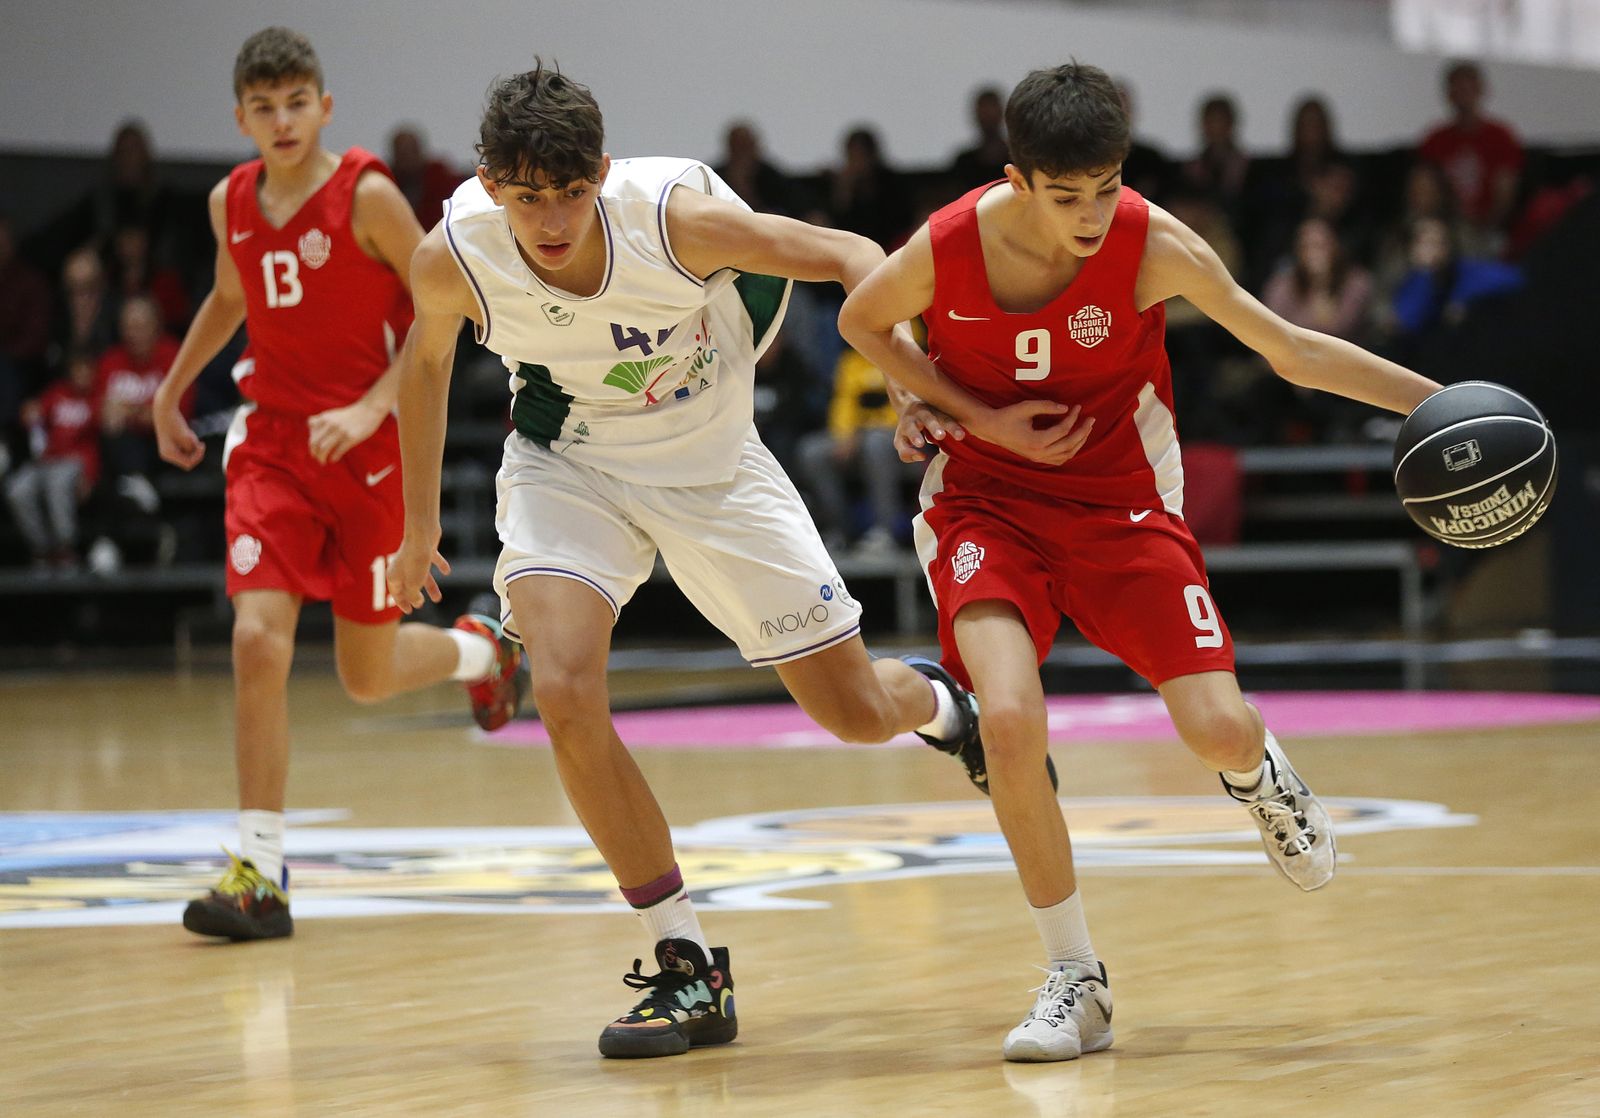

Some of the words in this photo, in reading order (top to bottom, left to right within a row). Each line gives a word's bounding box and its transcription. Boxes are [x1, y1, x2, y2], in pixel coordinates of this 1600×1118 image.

[261, 250, 303, 308] 13
[1015, 328, 1051, 381] 9
[1070, 326, 1109, 339] GIRONA
[1430, 480, 1537, 534] MINICOPA
[1447, 484, 1512, 519] ENDESA
[370, 554, 400, 611] 1
[1183, 584, 1224, 648] 9
